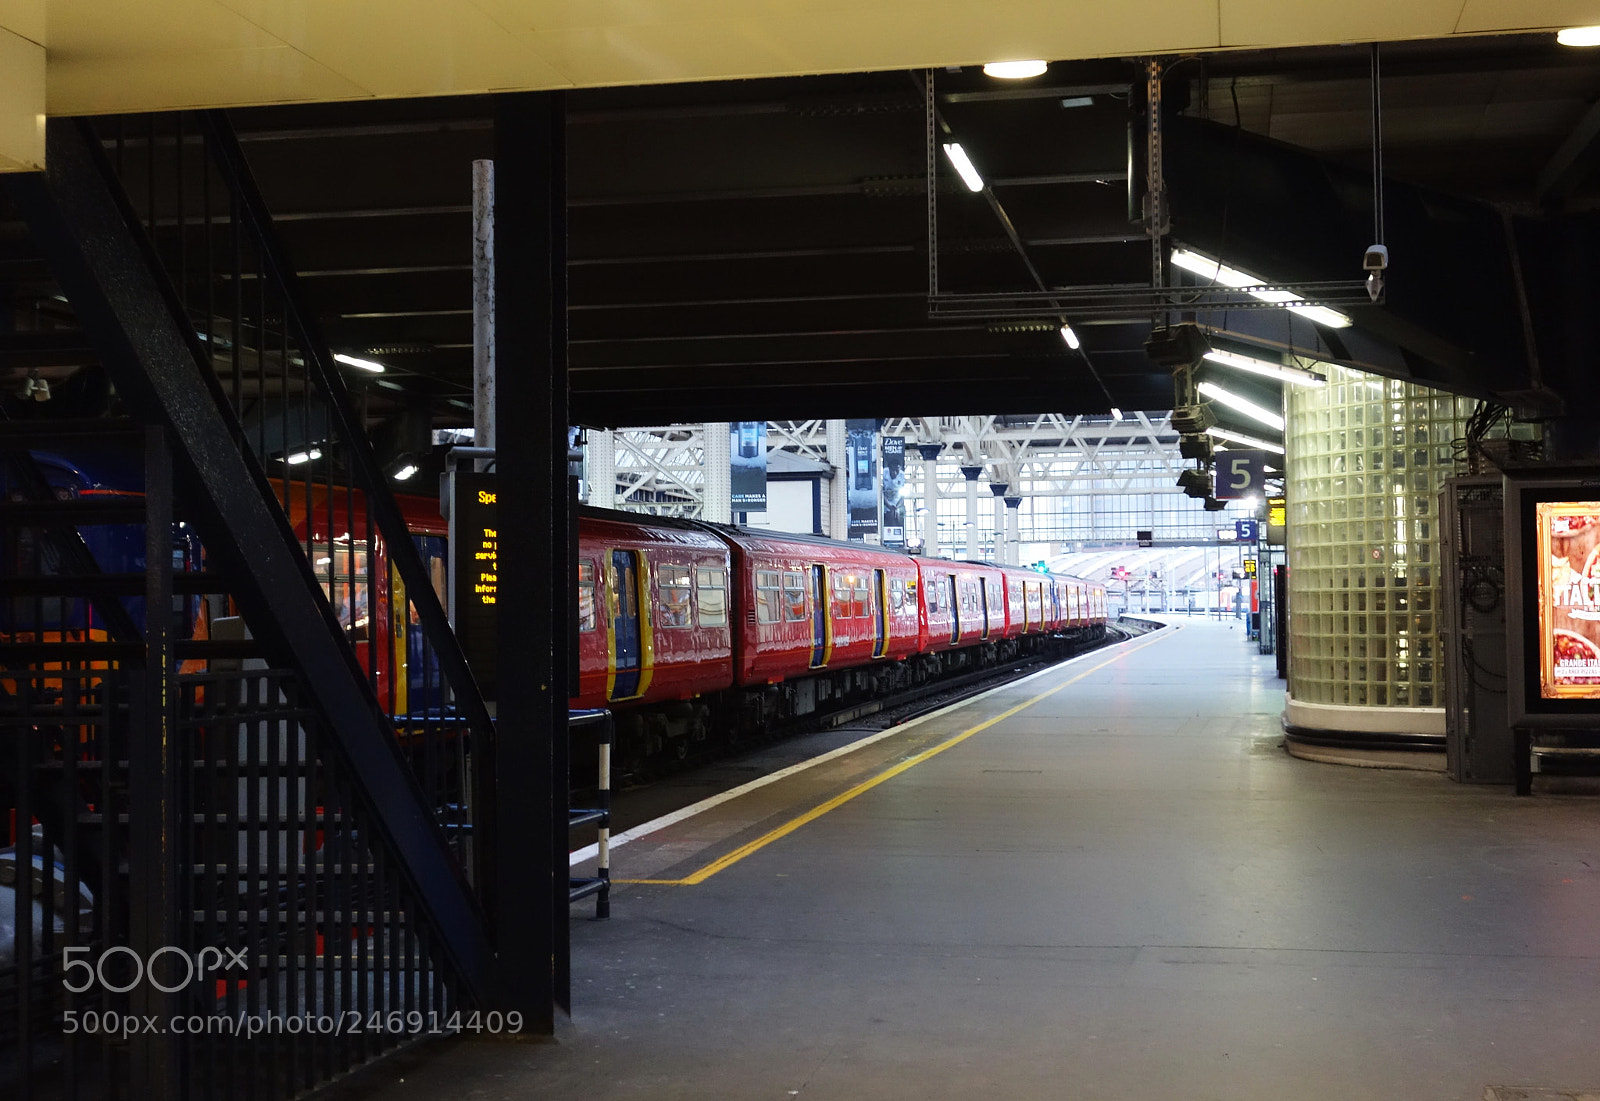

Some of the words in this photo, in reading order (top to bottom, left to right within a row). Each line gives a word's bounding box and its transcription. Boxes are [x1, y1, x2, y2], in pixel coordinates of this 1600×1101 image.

[884, 438, 903, 446] Dove
[1230, 459, 1251, 489] 5
[1241, 524, 1250, 538] 5
[482, 541, 492, 549] no
[481, 595, 496, 604] the
[1560, 658, 1587, 667] GRANDE
